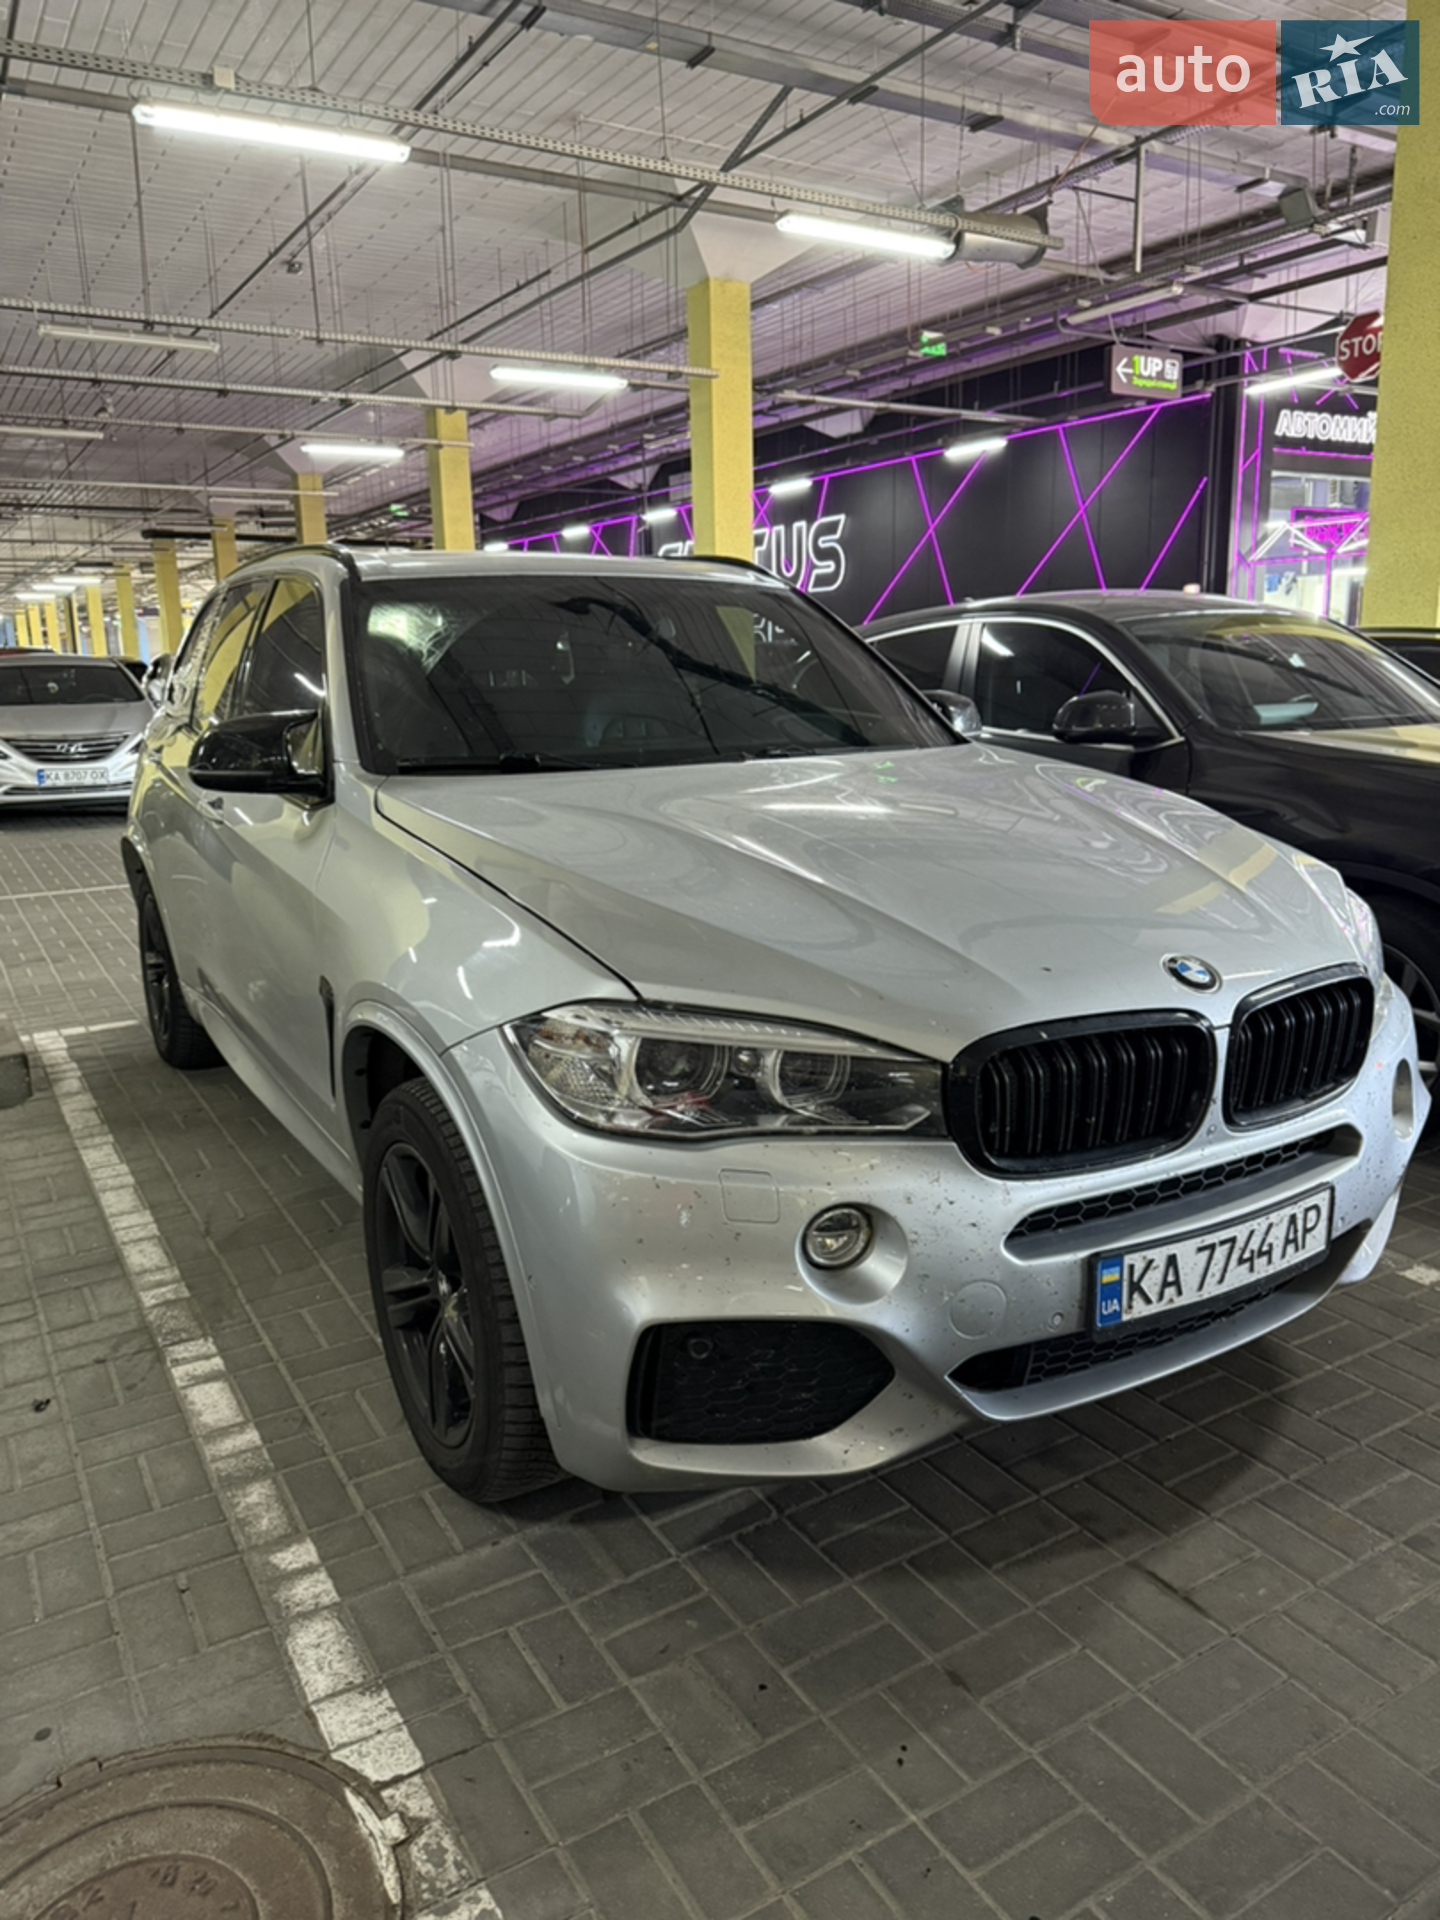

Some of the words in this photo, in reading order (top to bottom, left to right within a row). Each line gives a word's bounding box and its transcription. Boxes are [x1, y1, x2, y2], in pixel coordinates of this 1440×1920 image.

[46, 772, 61, 781] KA
[1126, 1252, 1184, 1310] KA
[1196, 1222, 1274, 1293] 7744
[1280, 1203, 1322, 1260] AP
[1101, 1298, 1121, 1316] UA
